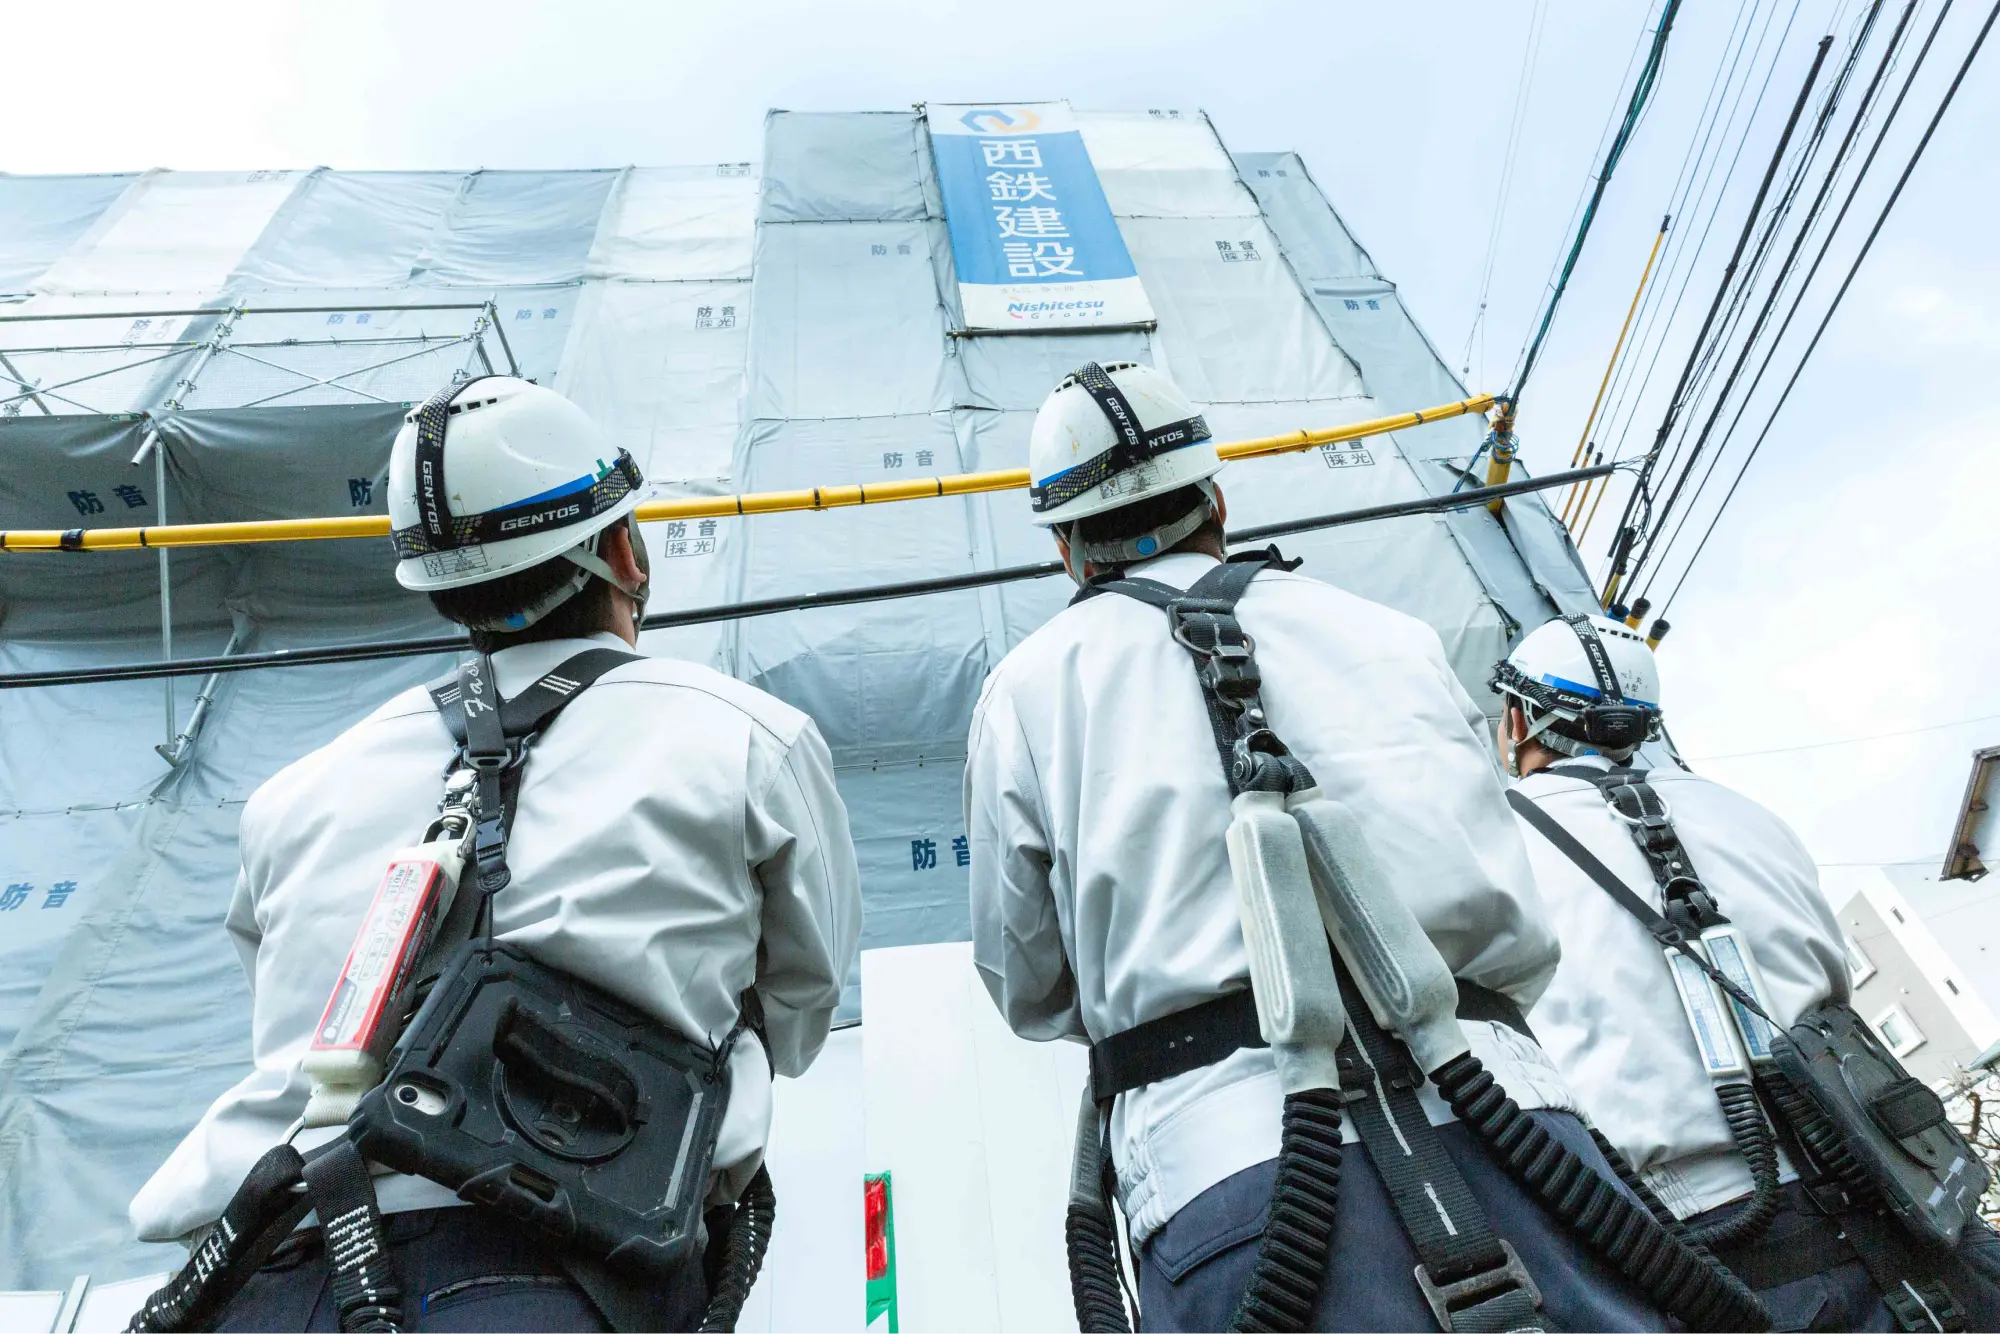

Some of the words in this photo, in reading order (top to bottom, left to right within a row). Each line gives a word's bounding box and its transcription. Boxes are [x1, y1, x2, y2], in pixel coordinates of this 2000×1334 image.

[979, 140, 1084, 277] 西鉄建設
[871, 244, 911, 256] 防音
[1215, 240, 1254, 251] 防音
[697, 306, 736, 317] 防音
[1007, 300, 1105, 312] Nishitetsu
[1343, 299, 1380, 311] 防音
[700, 317, 732, 327] 採光
[1030, 310, 1103, 320] Group
[1106, 397, 1140, 446] GENTOS
[1148, 429, 1184, 449] NTOS
[883, 450, 934, 469] 防音
[1328, 453, 1370, 466] 採光
[66, 484, 148, 516] 防音
[423, 460, 442, 535] GENTOS
[500, 503, 580, 531] GENTOS
[667, 520, 718, 539] 防音
[669, 540, 711, 555] 採光
[1589, 643, 1614, 691] GENTOS
[1557, 694, 1589, 706] GEN
[911, 835, 971, 871] 防音
[0, 880, 78, 911] 防音
[388, 966, 405, 1002] SHOCK
